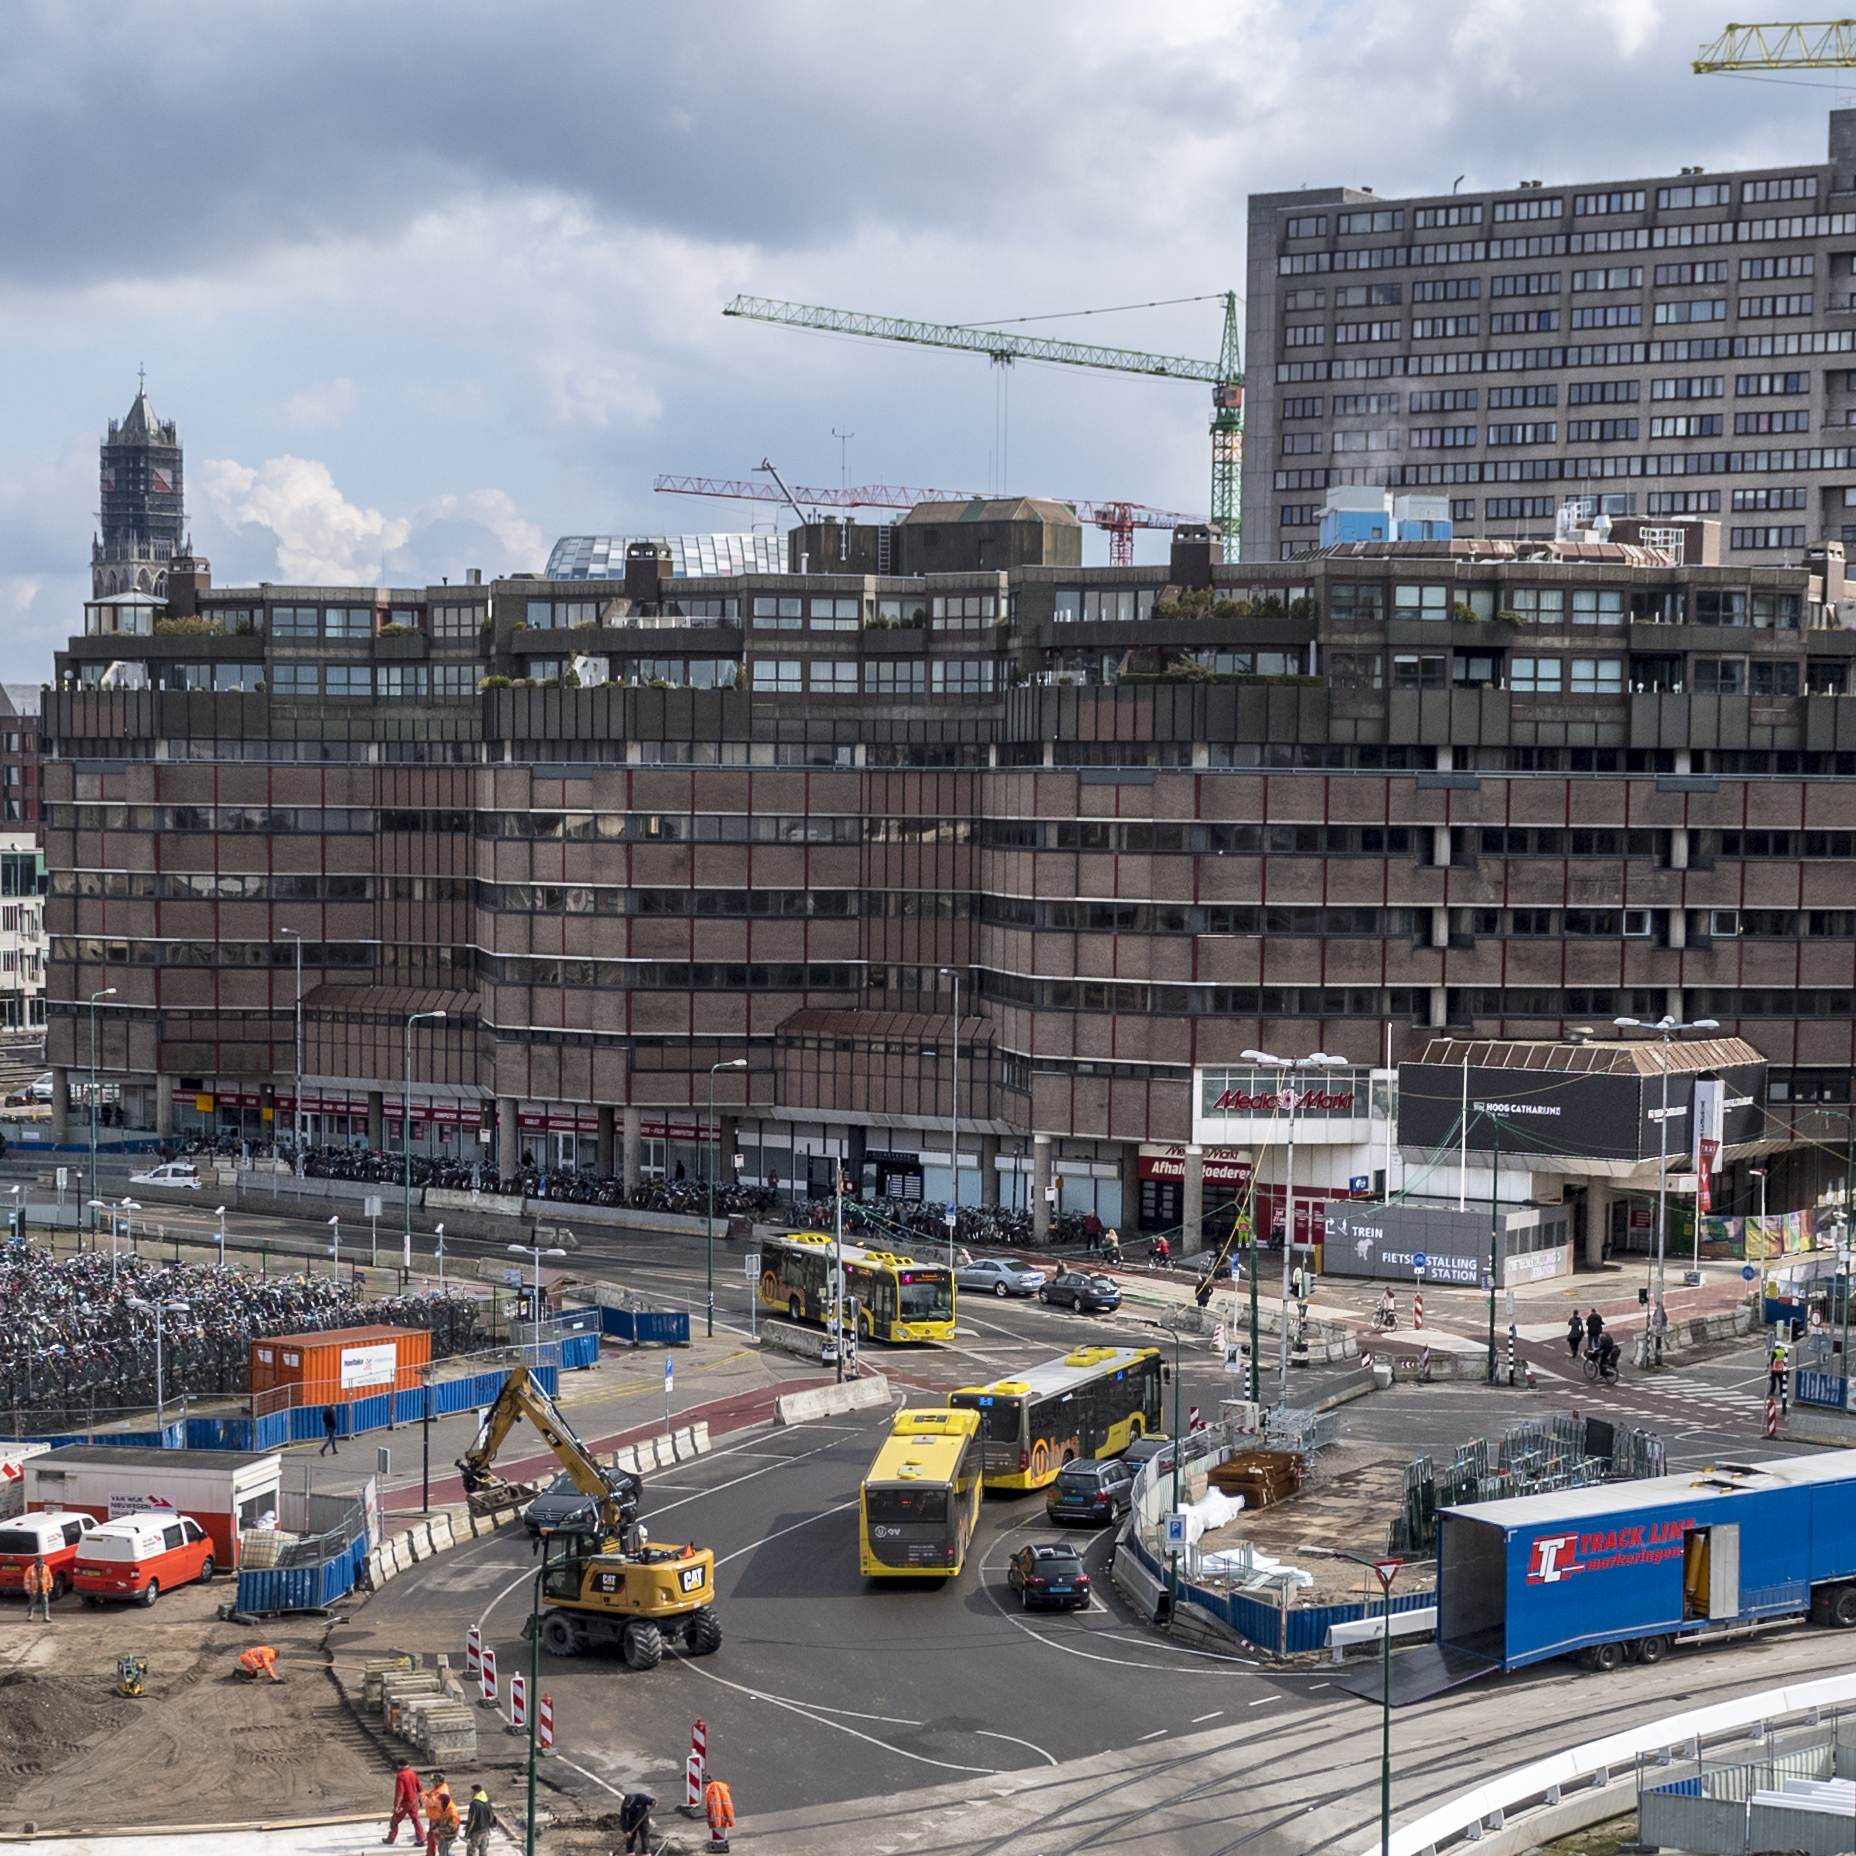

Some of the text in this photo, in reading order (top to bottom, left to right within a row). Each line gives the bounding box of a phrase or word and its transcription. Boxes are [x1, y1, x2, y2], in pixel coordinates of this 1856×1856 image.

[1212, 1088, 1355, 1111] Media Markt
[1486, 1102, 1510, 1112] HOOG
[1352, 1226, 1383, 1239] TREIN
[1382, 1252, 1477, 1270] FIETSSTALLING
[1431, 1267, 1478, 1282] STATION
[1580, 1525, 1645, 1553] TRACK
[602, 1574, 616, 1586] CAT
[684, 1567, 703, 1591] CAT
